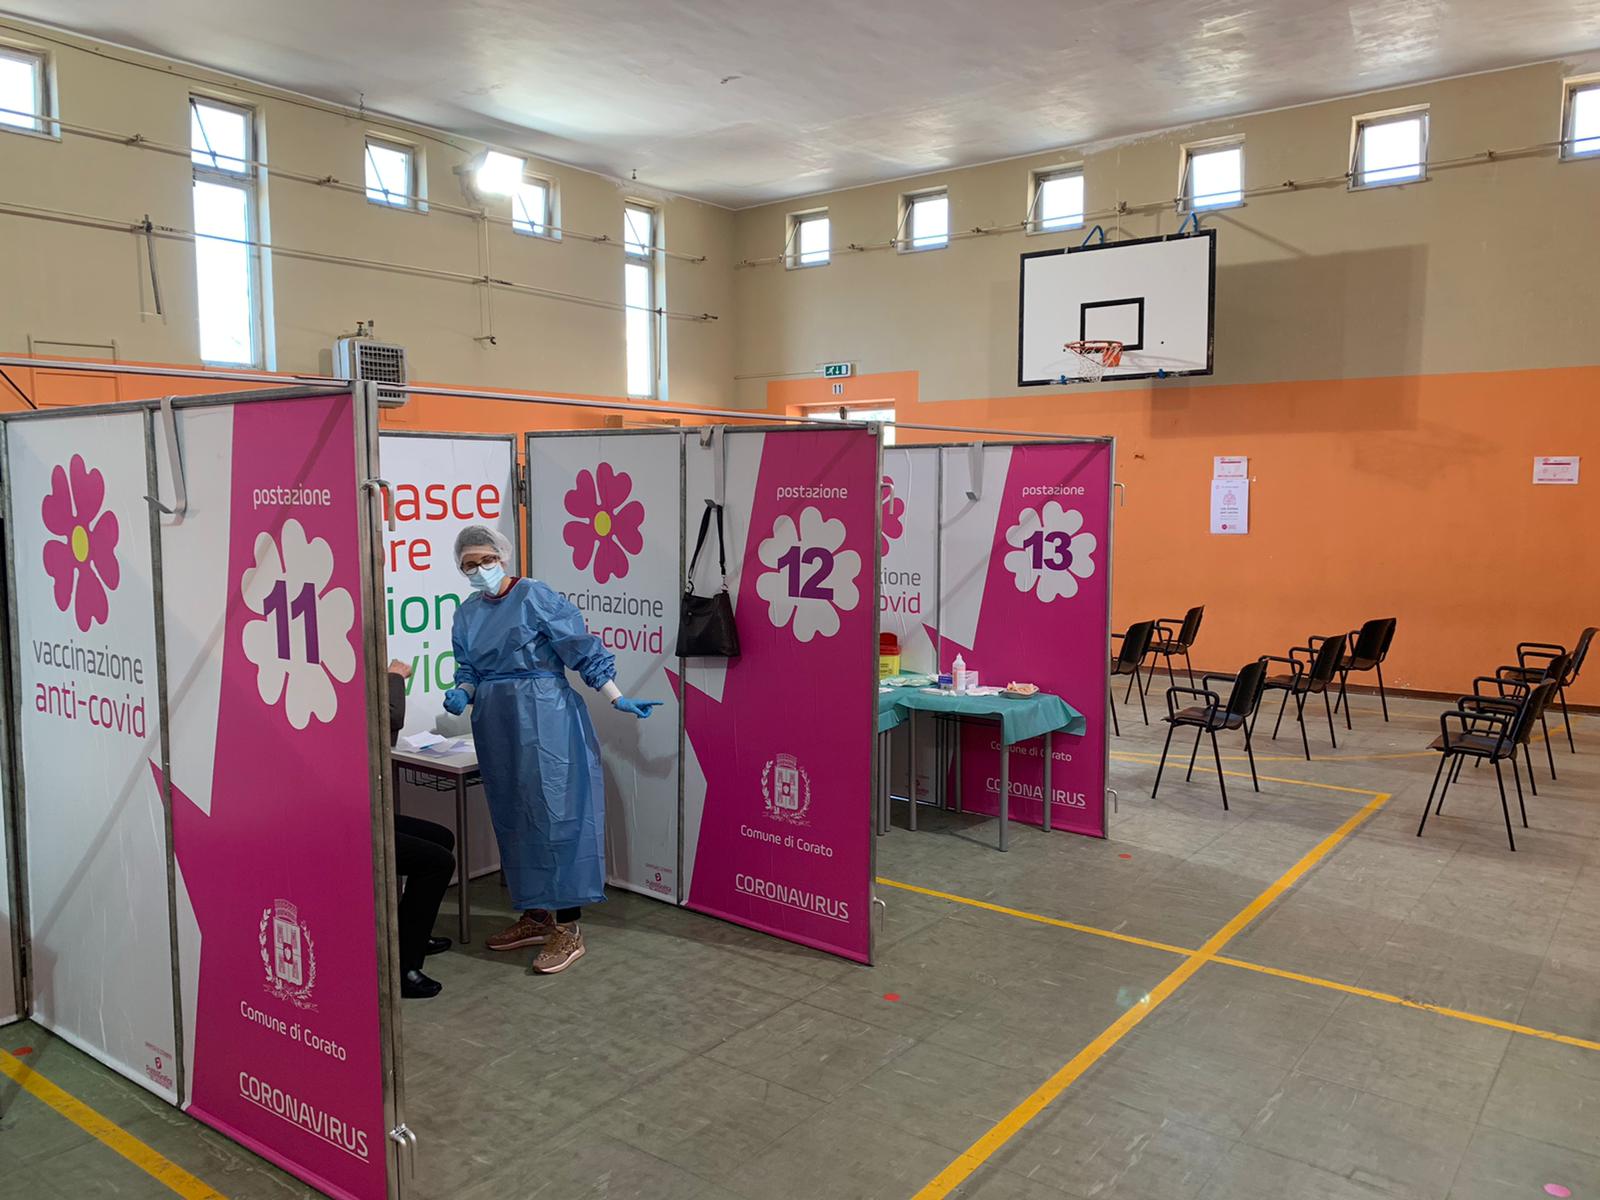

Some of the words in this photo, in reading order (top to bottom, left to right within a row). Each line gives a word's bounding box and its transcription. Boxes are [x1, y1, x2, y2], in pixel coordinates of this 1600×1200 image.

[253, 483, 331, 509] postazione
[776, 484, 848, 501] postazione
[1022, 484, 1085, 498] postazione
[384, 539, 431, 572] re
[1023, 531, 1073, 570] 13
[777, 546, 834, 600] 12
[880, 567, 921, 586] ione
[263, 579, 320, 664] 11
[33, 639, 144, 684] vaccinazione
[35, 681, 145, 738] anti-covid
[990, 740, 1027, 755] Coune
[1040, 750, 1072, 762] Crato
[986, 777, 1086, 806] CORONAIRUS
[740, 824, 782, 845] Comune
[784, 835, 795, 848] di
[796, 838, 833, 857] Corato
[735, 873, 849, 920] CORONAVIRUS
[240, 1001, 287, 1034] Comune
[290, 1021, 301, 1041] di
[304, 1029, 347, 1061] Corato
[239, 1071, 369, 1157] CORONAVIRUS
